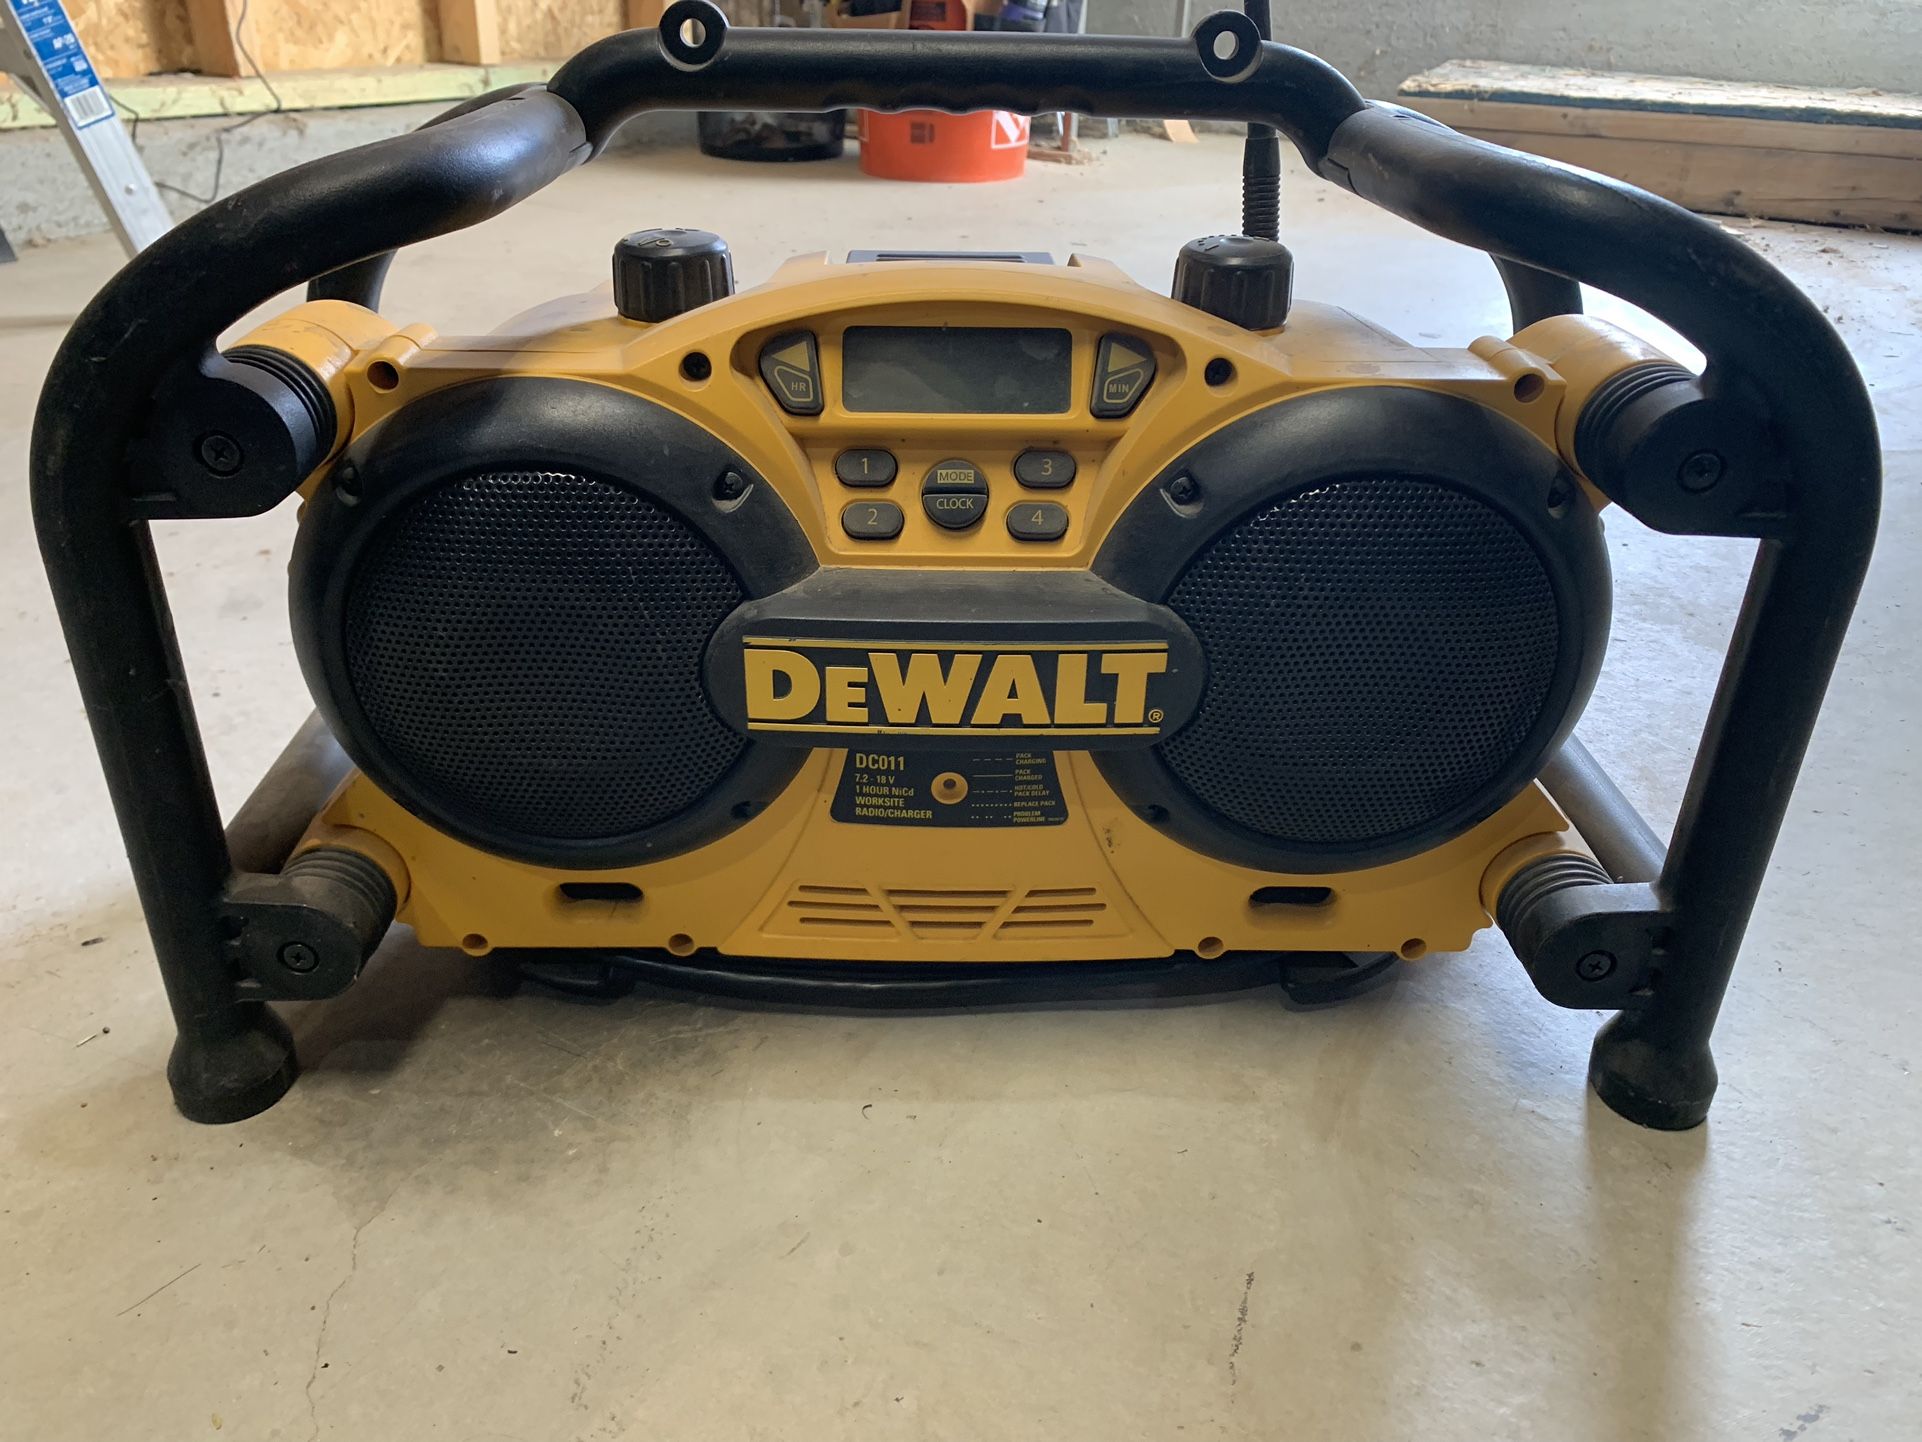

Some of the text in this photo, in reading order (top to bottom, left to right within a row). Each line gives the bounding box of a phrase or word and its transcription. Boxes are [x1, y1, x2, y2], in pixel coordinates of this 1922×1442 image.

[791, 382, 806, 392] HR
[1109, 383, 1130, 393] MIN
[862, 458, 871, 474] 1
[1041, 459, 1053, 475] 3
[938, 471, 974, 482] MODE
[936, 497, 974, 510] CLOCK
[867, 509, 878, 525] 2
[1031, 510, 1044, 525] 4
[855, 753, 904, 771] DC011
[855, 773, 869, 783] 7.2
[876, 775, 887, 784] 18
[888, 775, 895, 784] V
[855, 785, 914, 797] 1 HOUR NiCd
[855, 796, 905, 807] WORKSITE
[855, 807, 933, 819] RADIO/CHARGER
